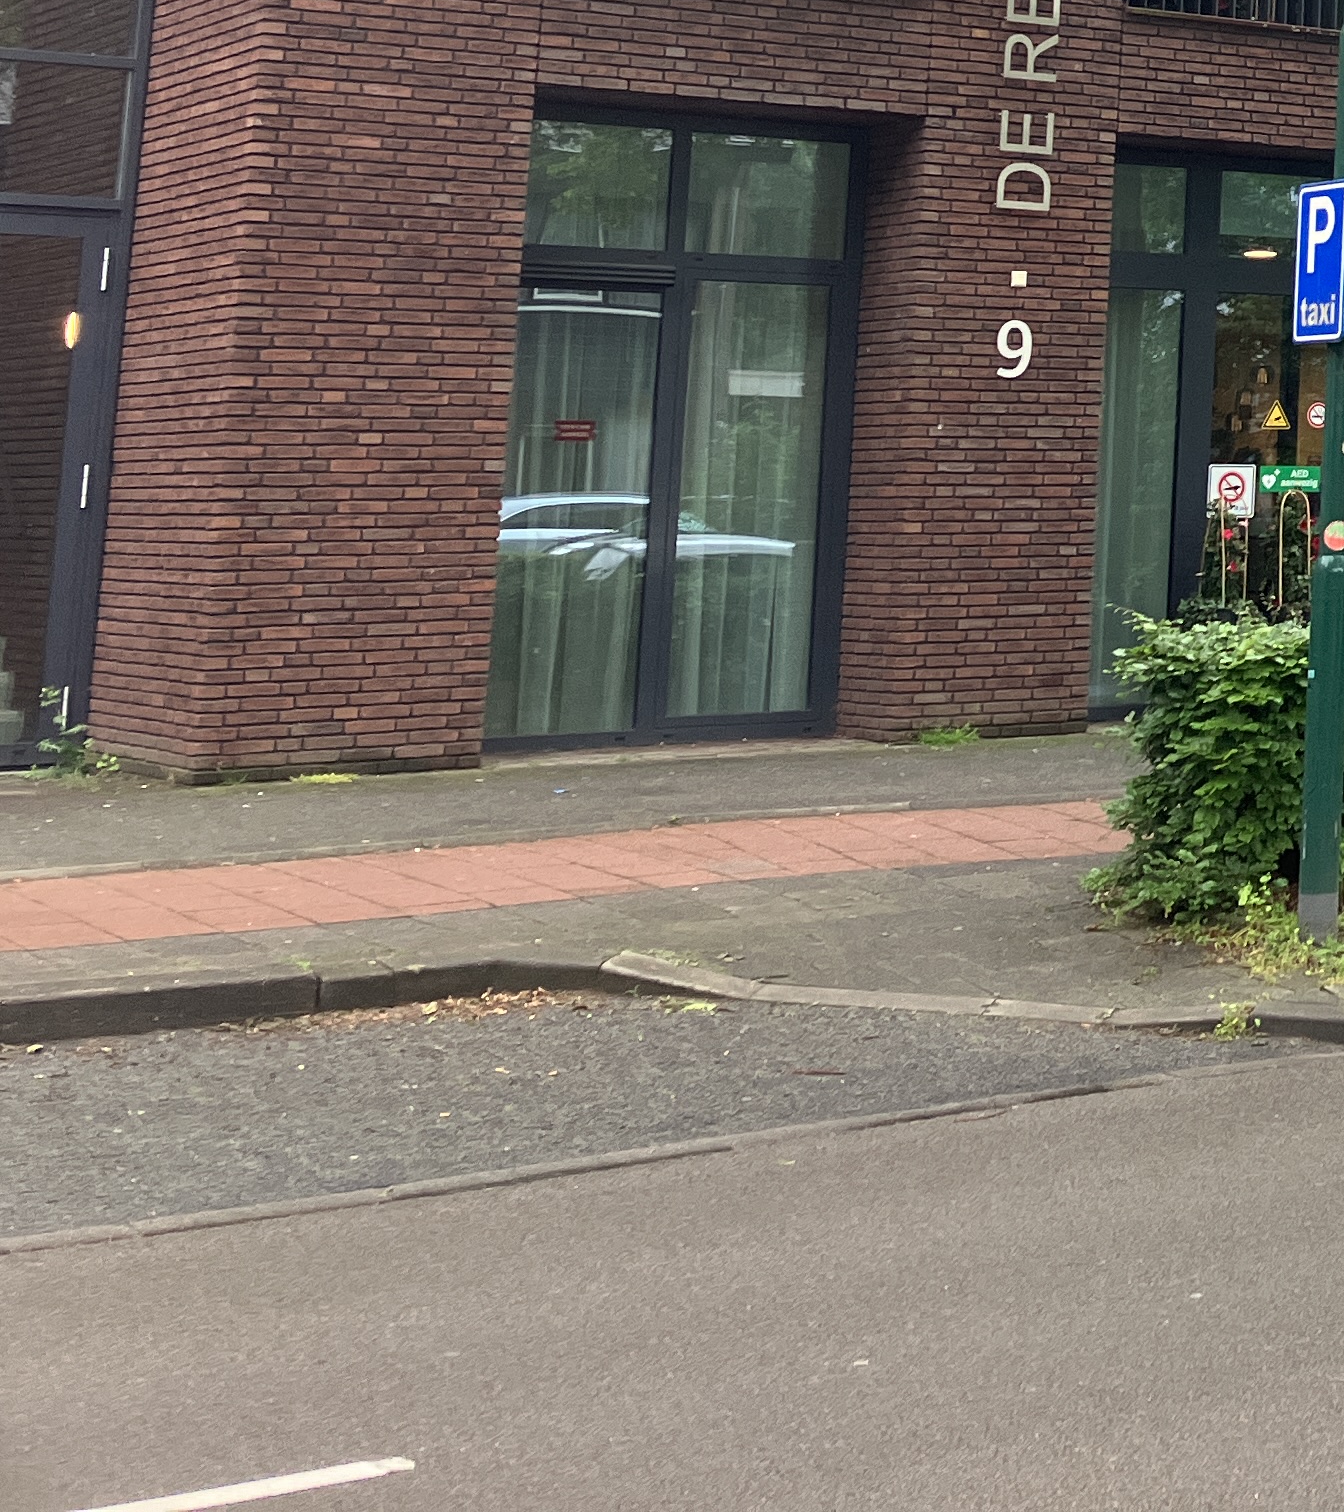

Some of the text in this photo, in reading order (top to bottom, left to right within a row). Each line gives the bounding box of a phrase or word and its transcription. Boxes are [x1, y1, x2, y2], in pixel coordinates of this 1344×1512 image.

[995, 109, 1055, 211] DE
[1306, 195, 1336, 274] P
[1300, 293, 1337, 327] taxi
[996, 319, 1033, 379] 9
[1289, 468, 1310, 478] AED
